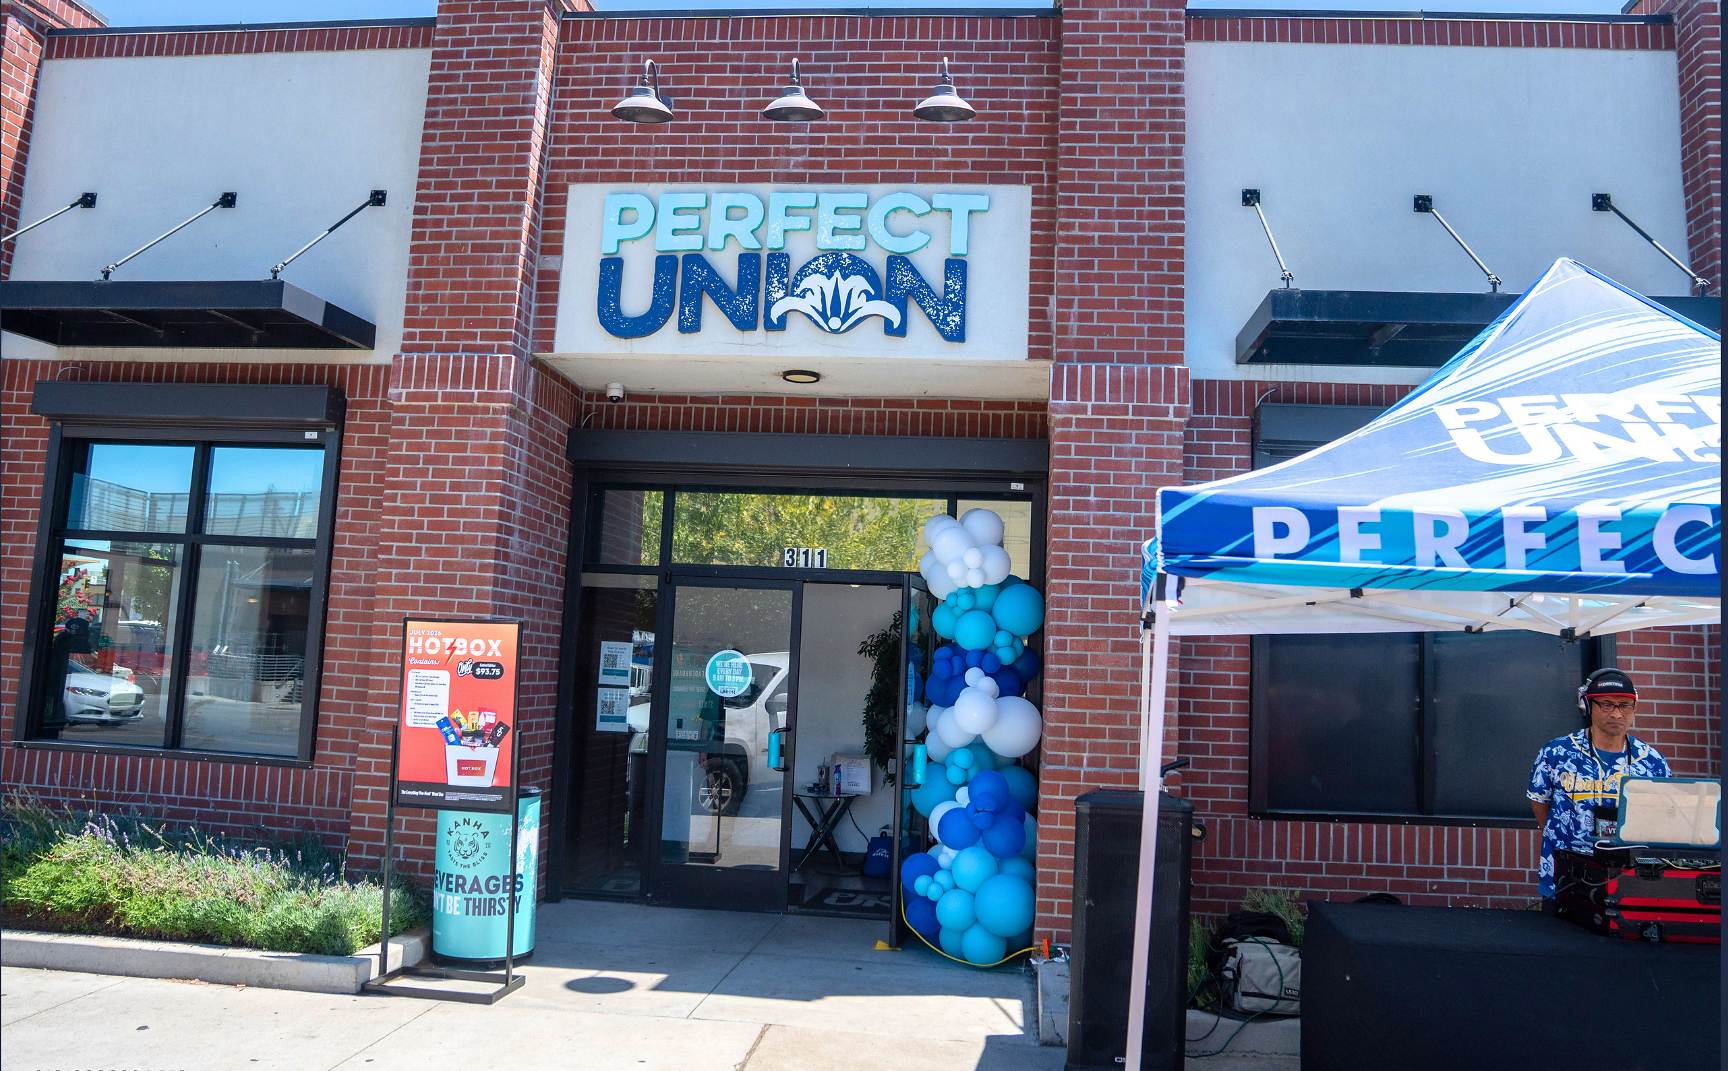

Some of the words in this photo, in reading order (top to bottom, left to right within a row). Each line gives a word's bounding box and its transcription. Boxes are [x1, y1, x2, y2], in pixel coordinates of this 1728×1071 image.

[602, 192, 989, 255] PERFECT
[597, 252, 967, 342] UNION
[1252, 504, 1718, 575] PERFEC
[786, 547, 825, 568] 311
[408, 636, 503, 656] HOTBOX
[475, 667, 501, 676] $93.75
[716, 660, 731, 668] WE'RE
[731, 661, 743, 669] HERE
[733, 668, 743, 676] DAY
[1561, 772, 1614, 792] Visual
[447, 817, 490, 839] KANHA
[472, 852, 488, 868] BLISS
[446, 894, 461, 916] BE
[463, 895, 522, 917] THIRSY
